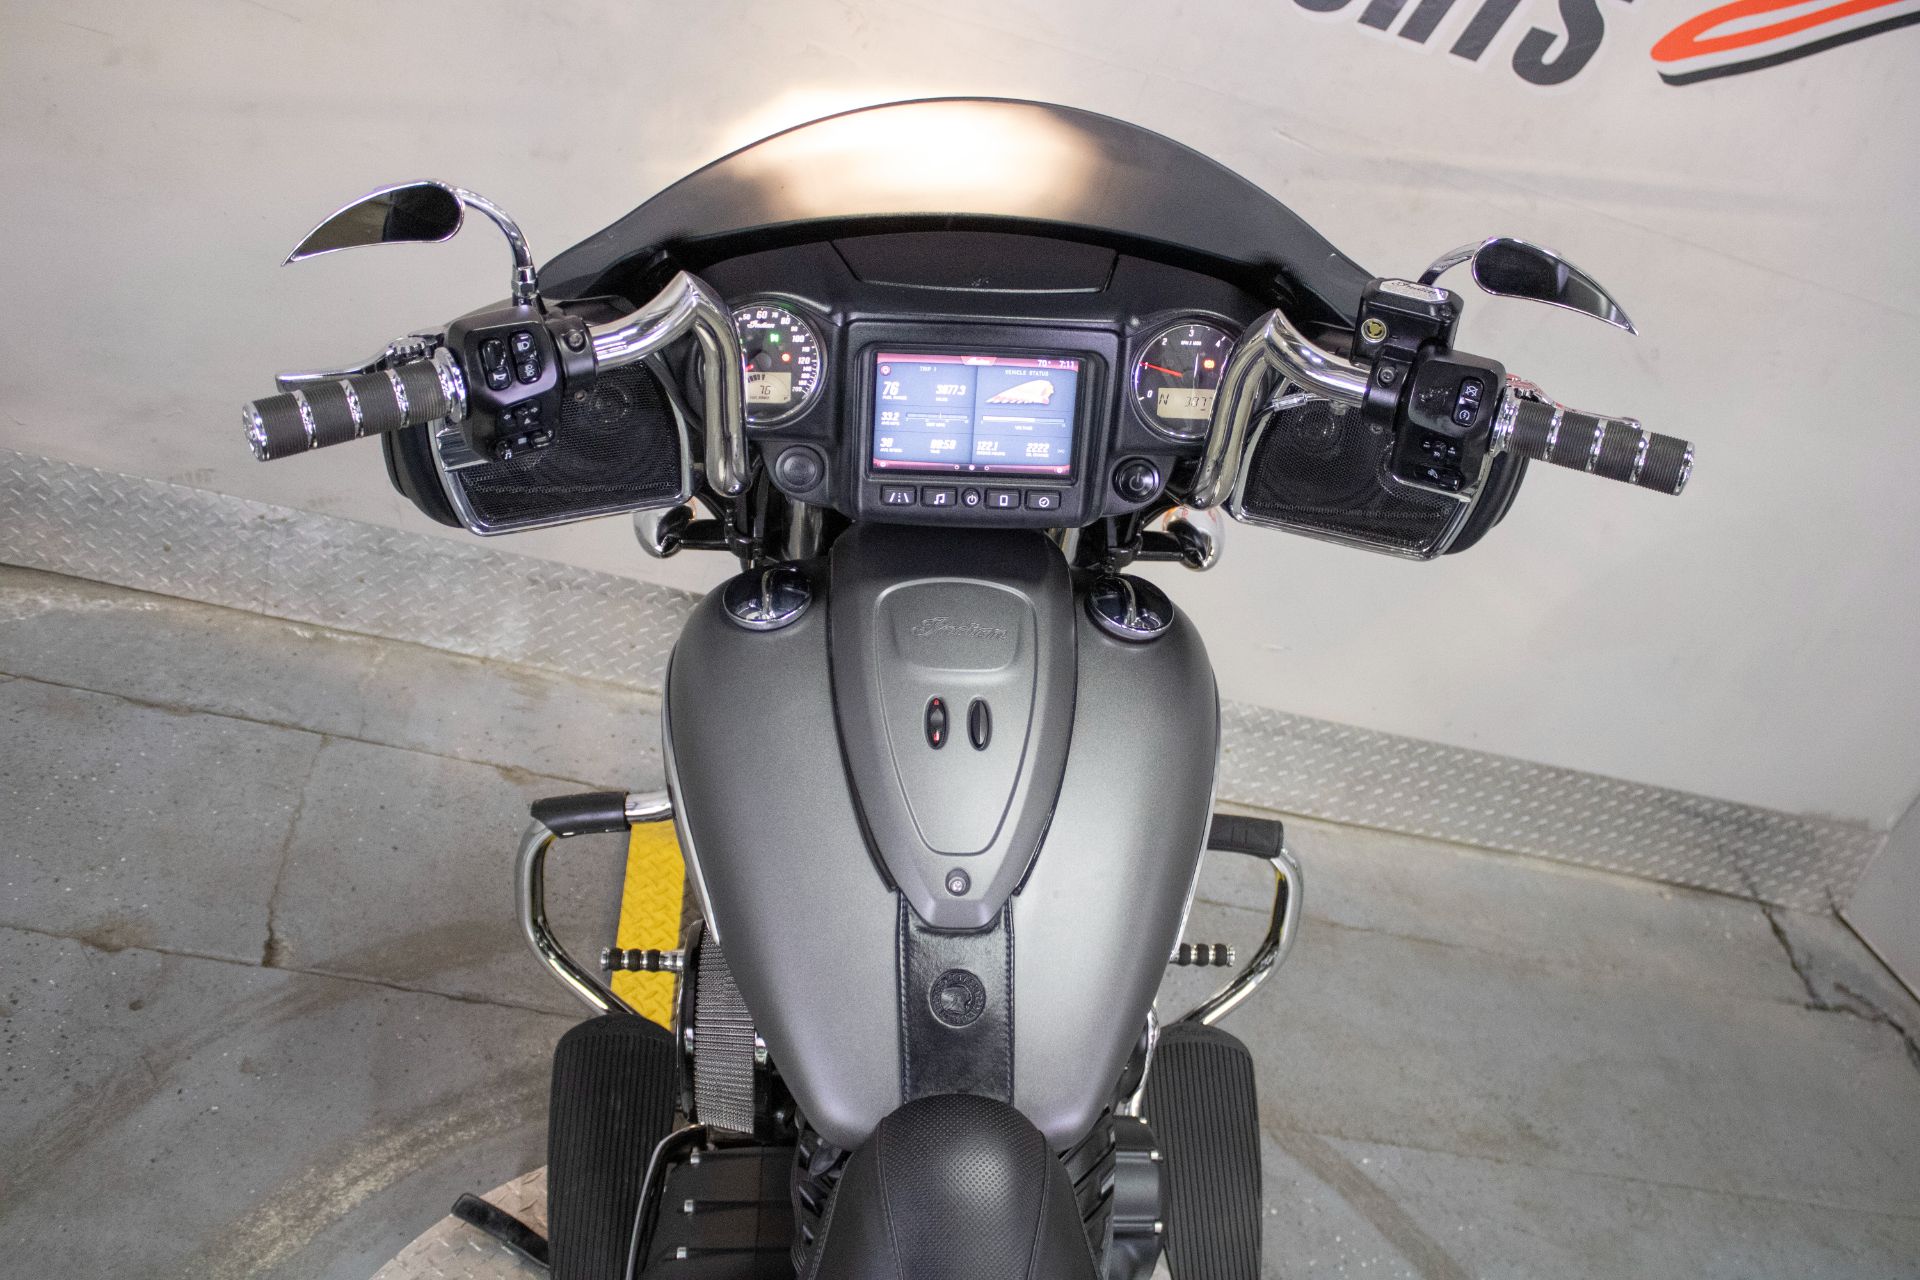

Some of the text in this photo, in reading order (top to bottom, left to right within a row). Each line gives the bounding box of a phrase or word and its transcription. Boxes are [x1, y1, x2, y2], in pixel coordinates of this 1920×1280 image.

[756, 310, 768, 319] 60
[747, 319, 775, 329] Indian
[1189, 329, 1194, 337] 3
[1162, 338, 1167, 346] 2
[1215, 340, 1221, 348] 4
[798, 357, 810, 365] 120
[760, 385, 771, 395] 76
[882, 381, 900, 396] 76
[1147, 390, 1153, 398] 0
[1158, 393, 1169, 405] N
[911, 616, 1008, 640] Indian
